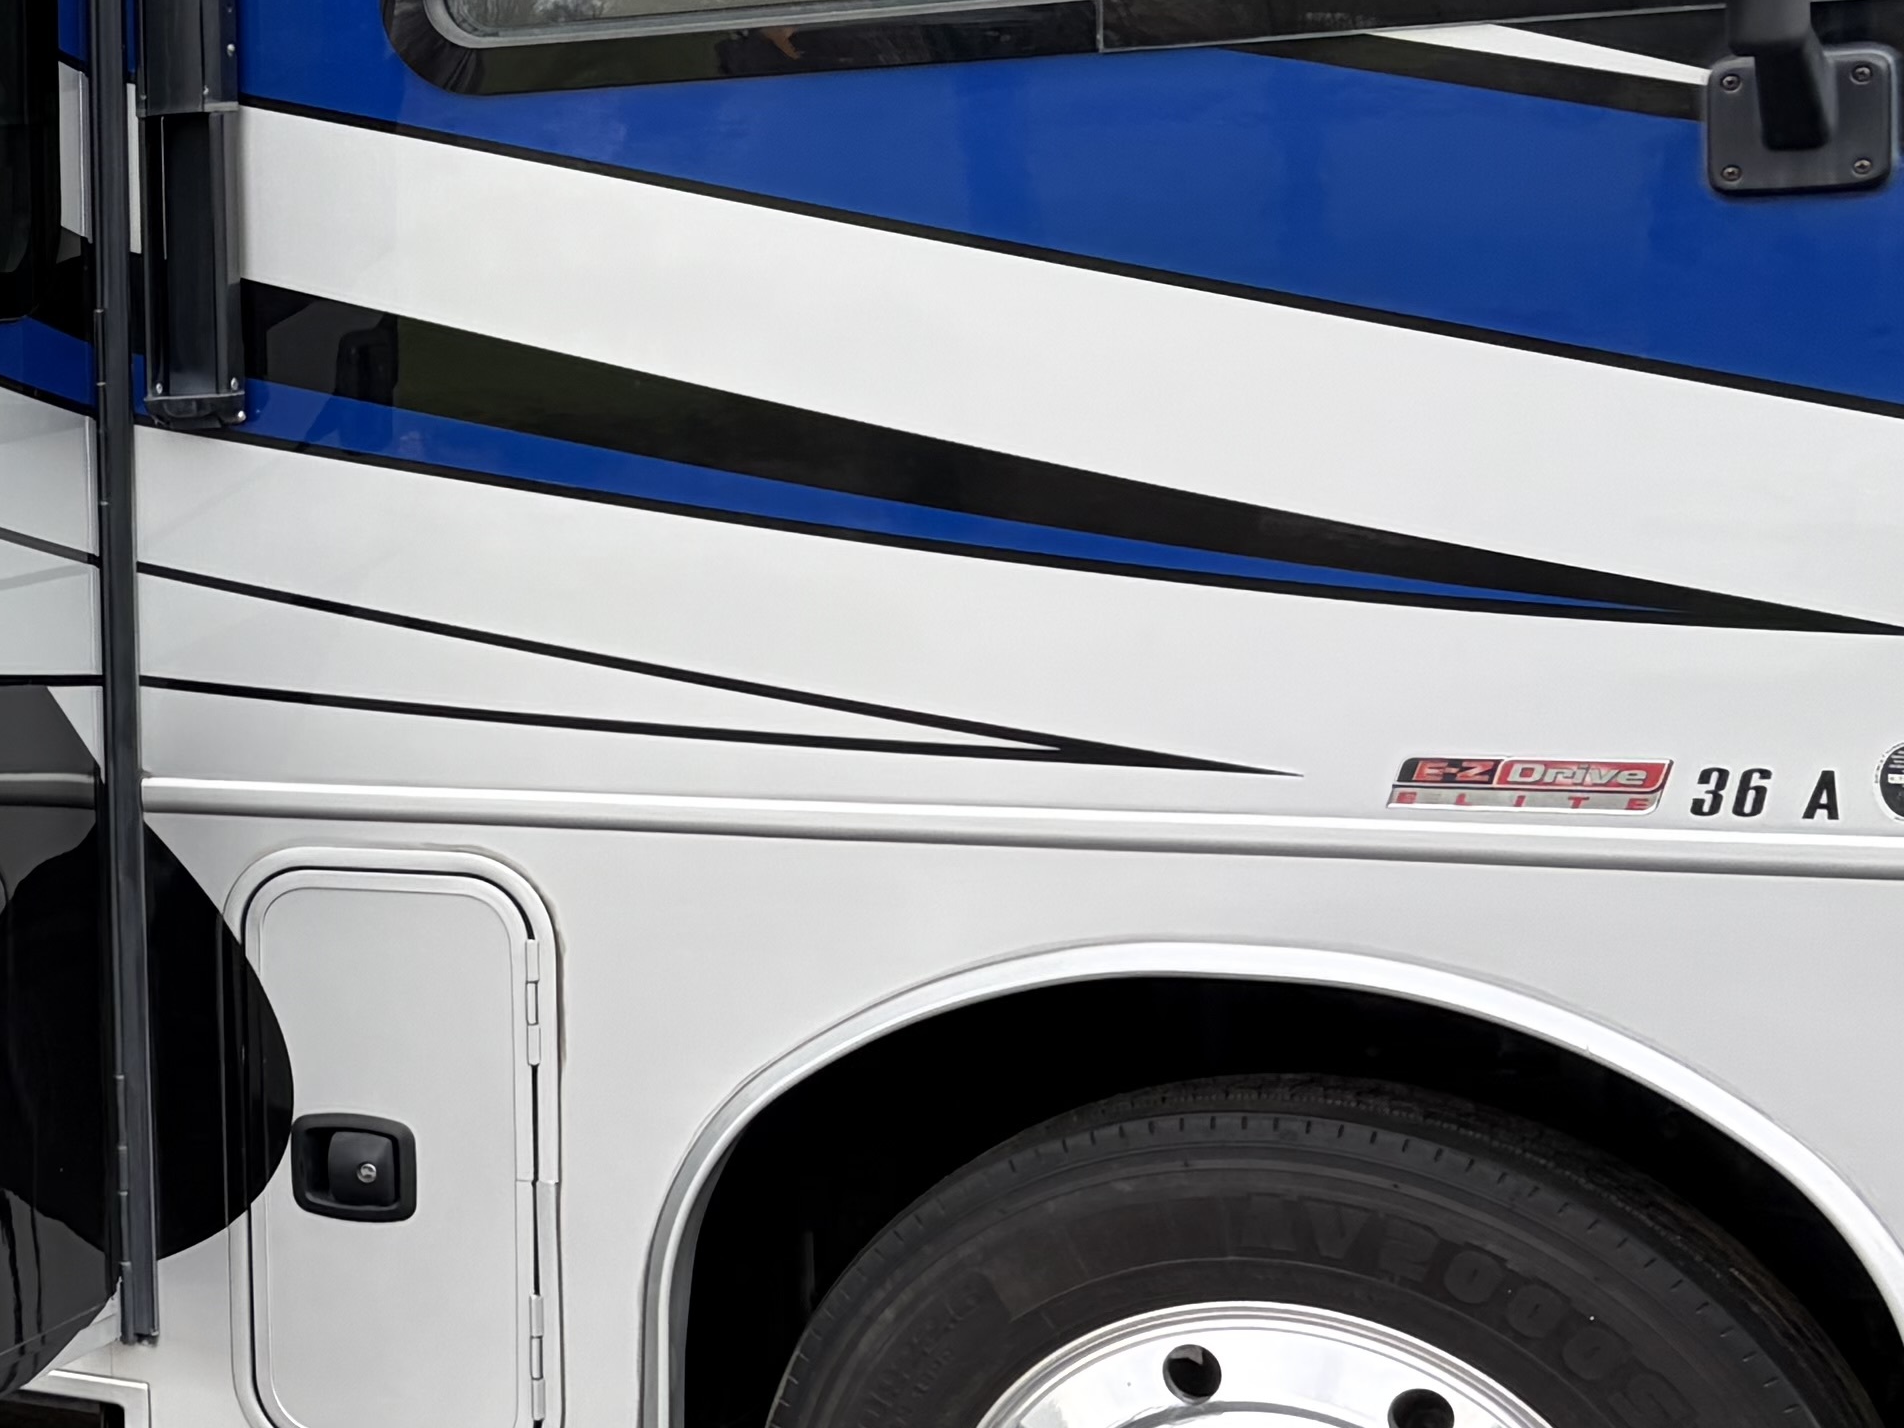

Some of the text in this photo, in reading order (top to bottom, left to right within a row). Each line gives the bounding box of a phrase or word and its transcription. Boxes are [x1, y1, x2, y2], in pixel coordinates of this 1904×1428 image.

[1413, 760, 1648, 786] E-Z Drive
[1396, 790, 1650, 812] ELITE
[1690, 766, 1840, 820] 36 A
